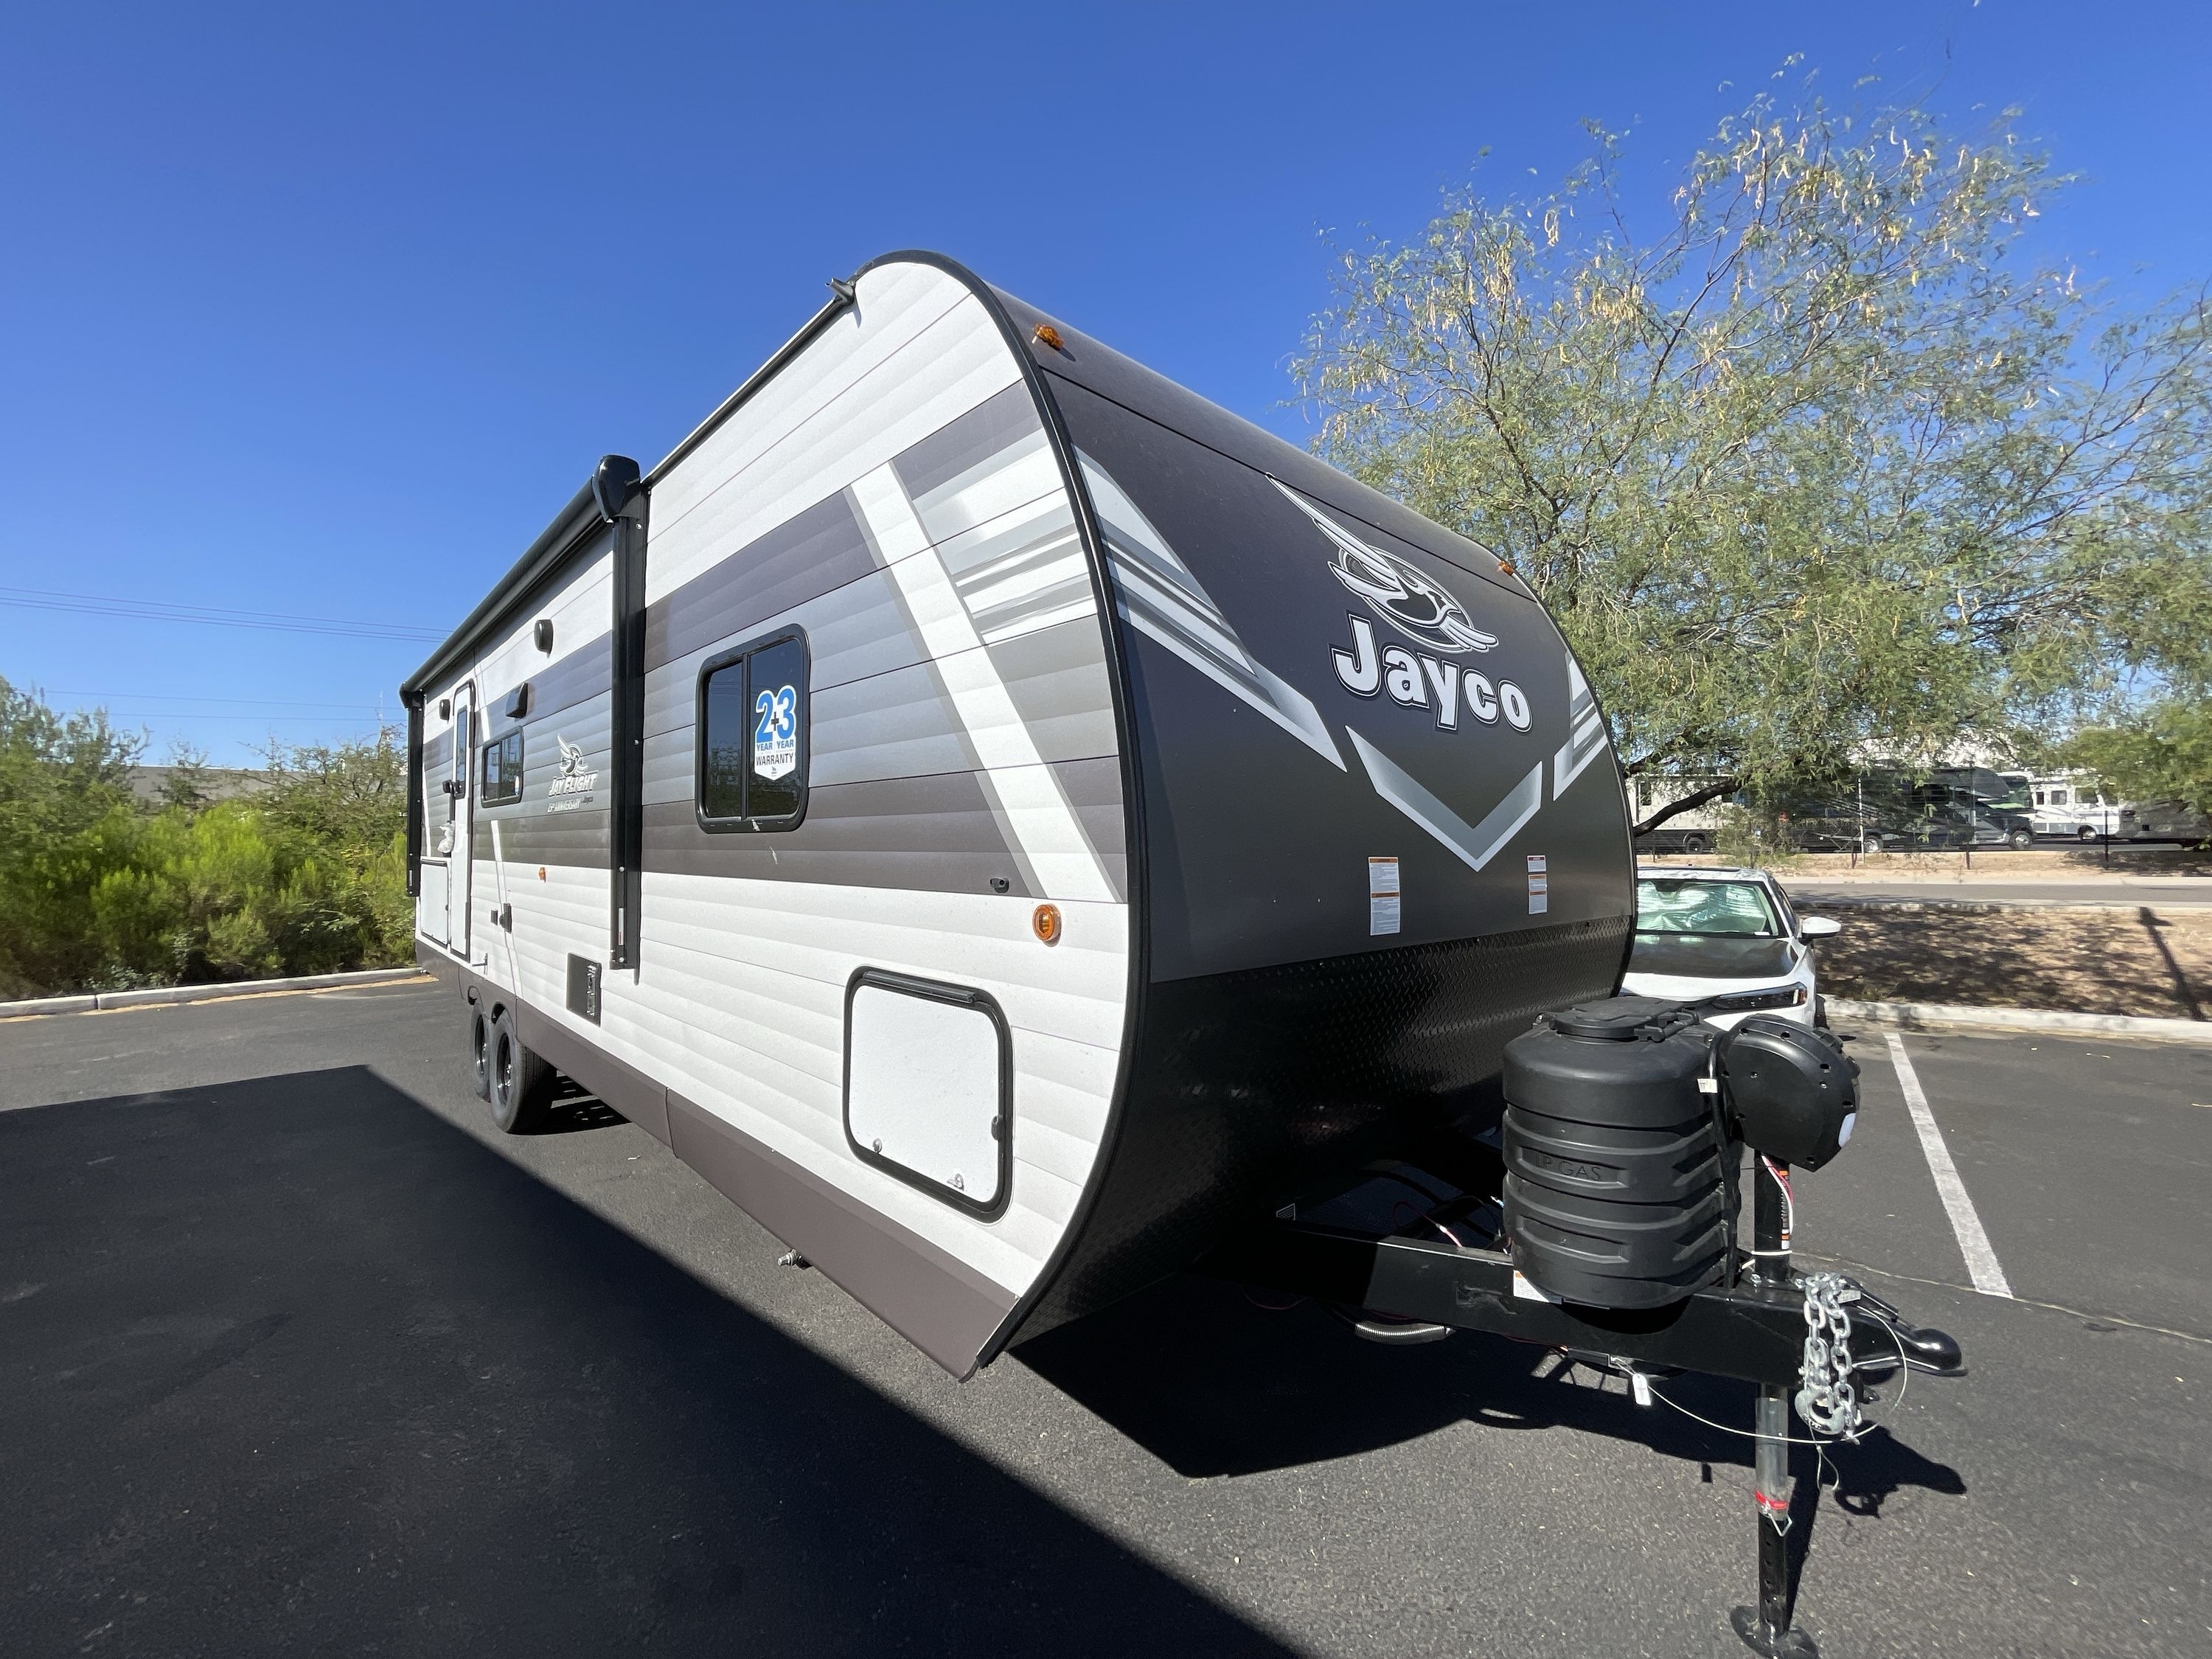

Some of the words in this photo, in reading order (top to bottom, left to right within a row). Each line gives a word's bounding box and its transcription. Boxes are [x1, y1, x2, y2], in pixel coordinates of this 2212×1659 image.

[1332, 613, 1533, 732] Jayco
[756, 742, 773, 751] YEAR
[776, 739, 794, 749] YEAR
[756, 752, 793, 766] WARRANTY
[549, 777, 566, 797] JAY
[563, 772, 598, 794] FLIGHT
[1535, 1152, 1554, 1169] LP
[1559, 1161, 1601, 1181] GAS
